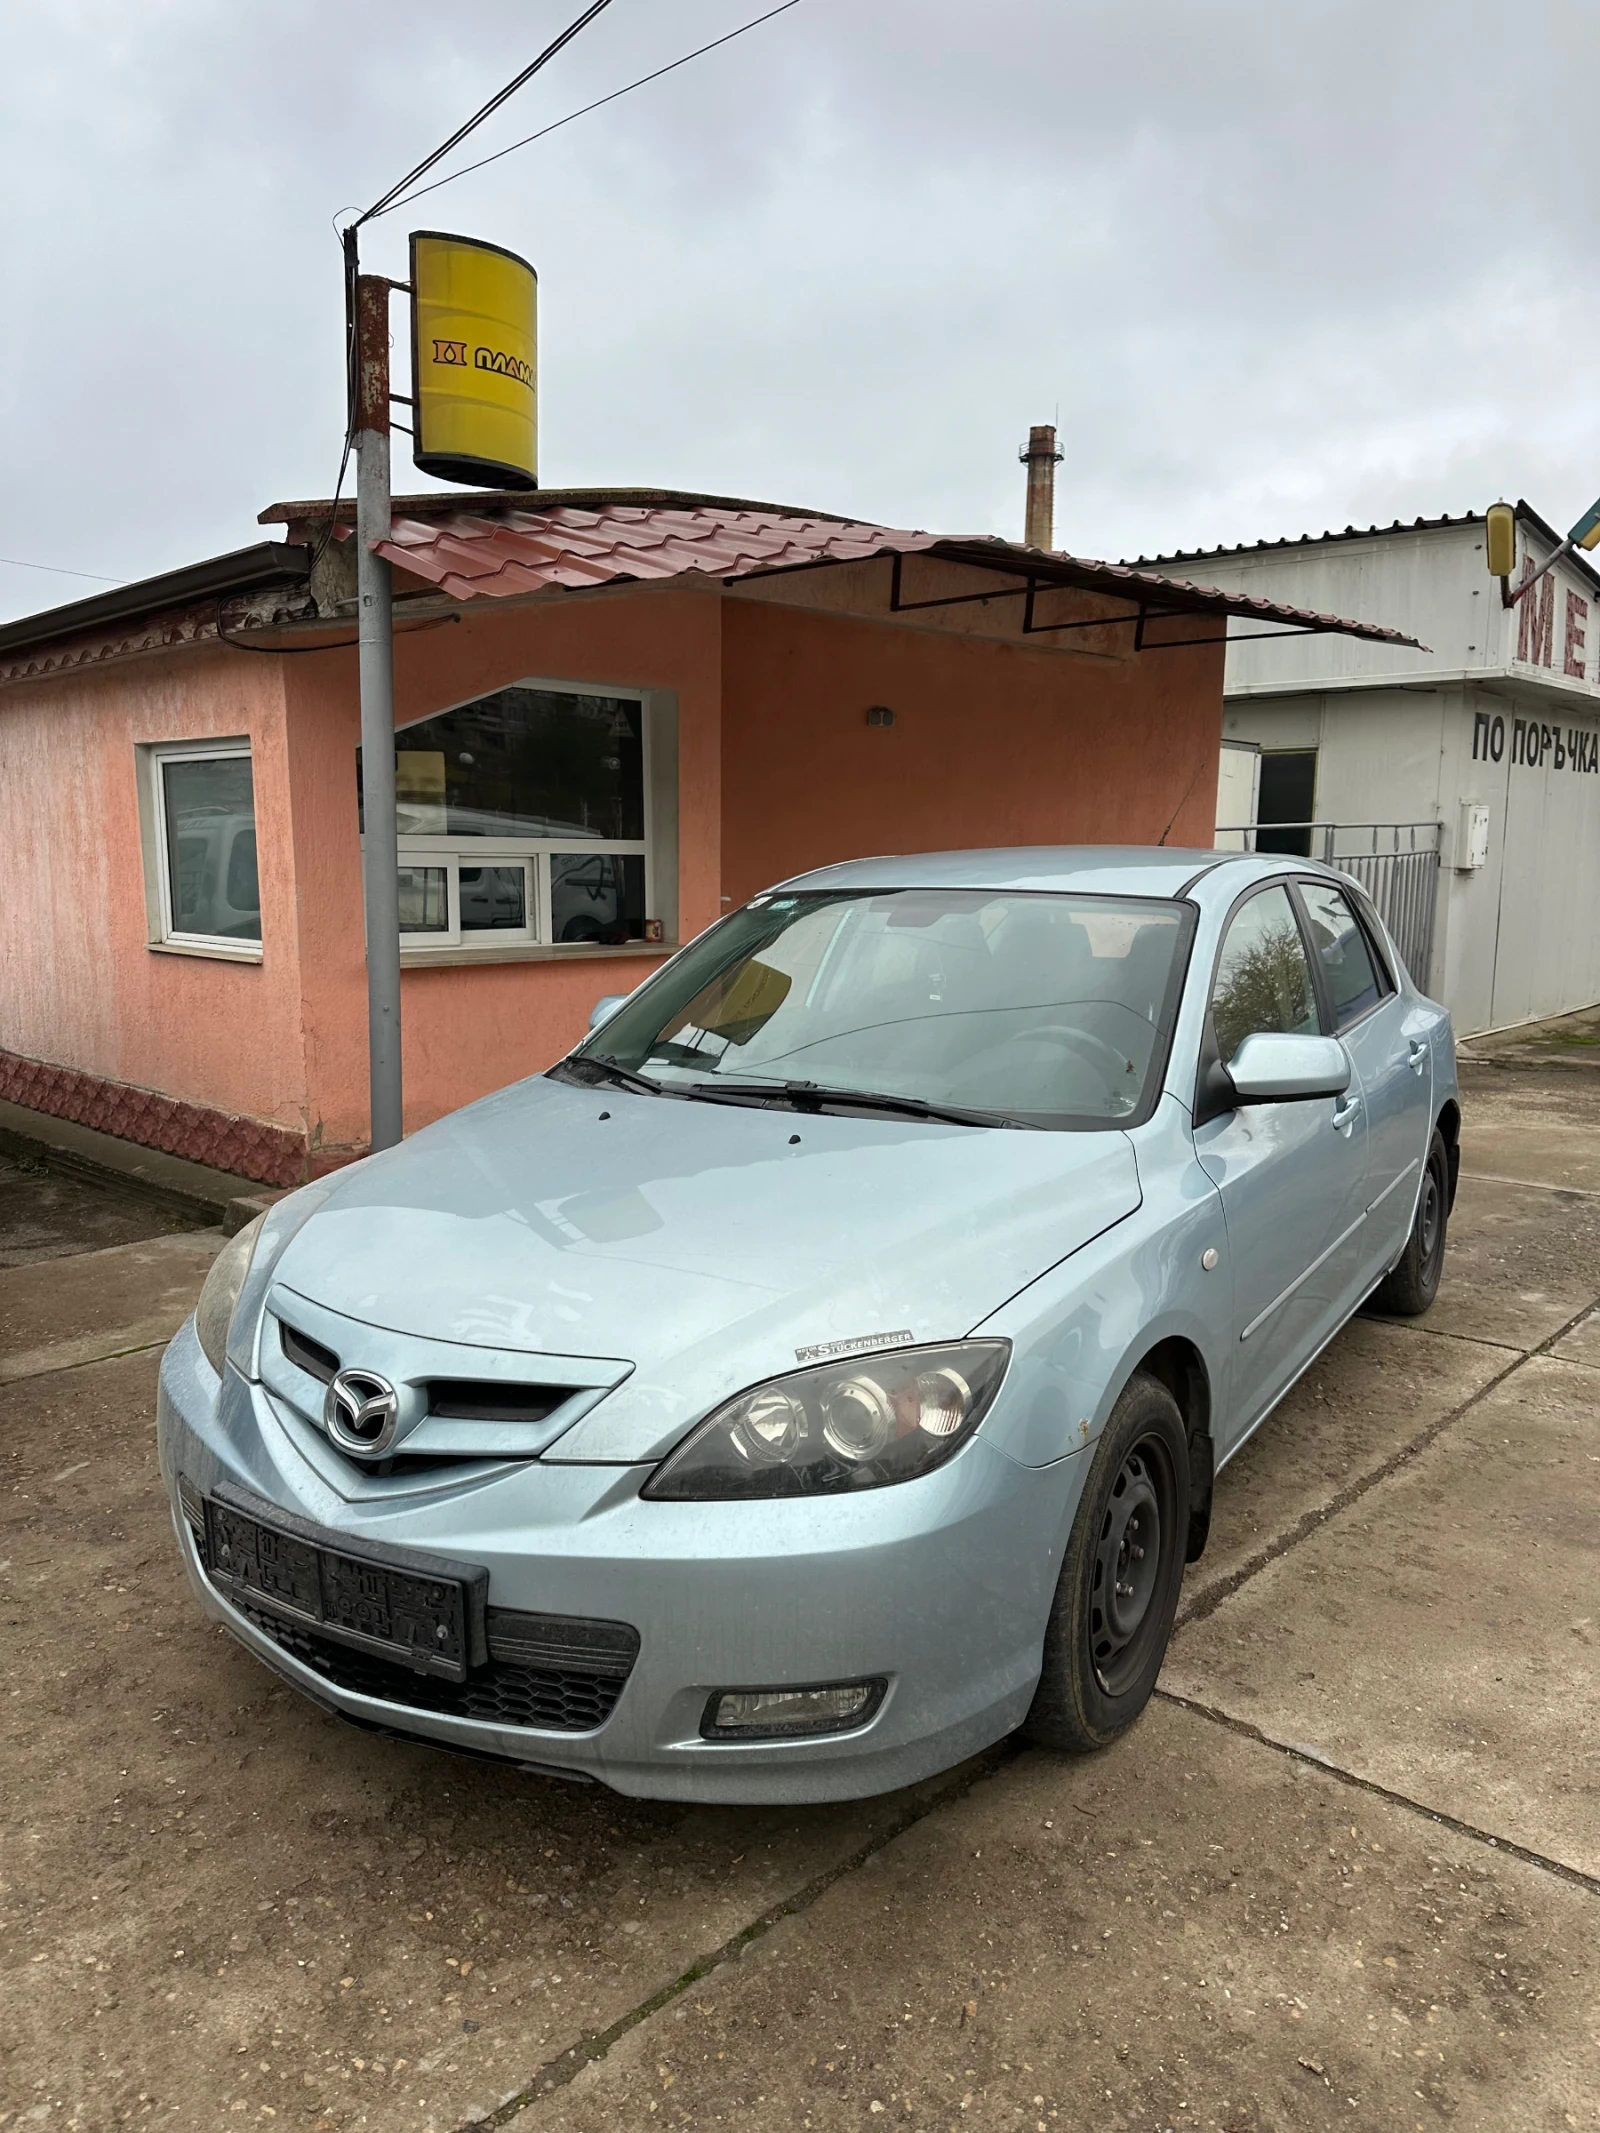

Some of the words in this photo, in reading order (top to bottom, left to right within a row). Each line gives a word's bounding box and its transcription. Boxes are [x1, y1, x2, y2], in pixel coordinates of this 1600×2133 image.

[475, 347, 535, 393] ПЛАМ
[1517, 555, 1600, 684] МЕ
[1472, 711, 1505, 763] ПО
[1512, 718, 1599, 773] ПОРЪЧКА
